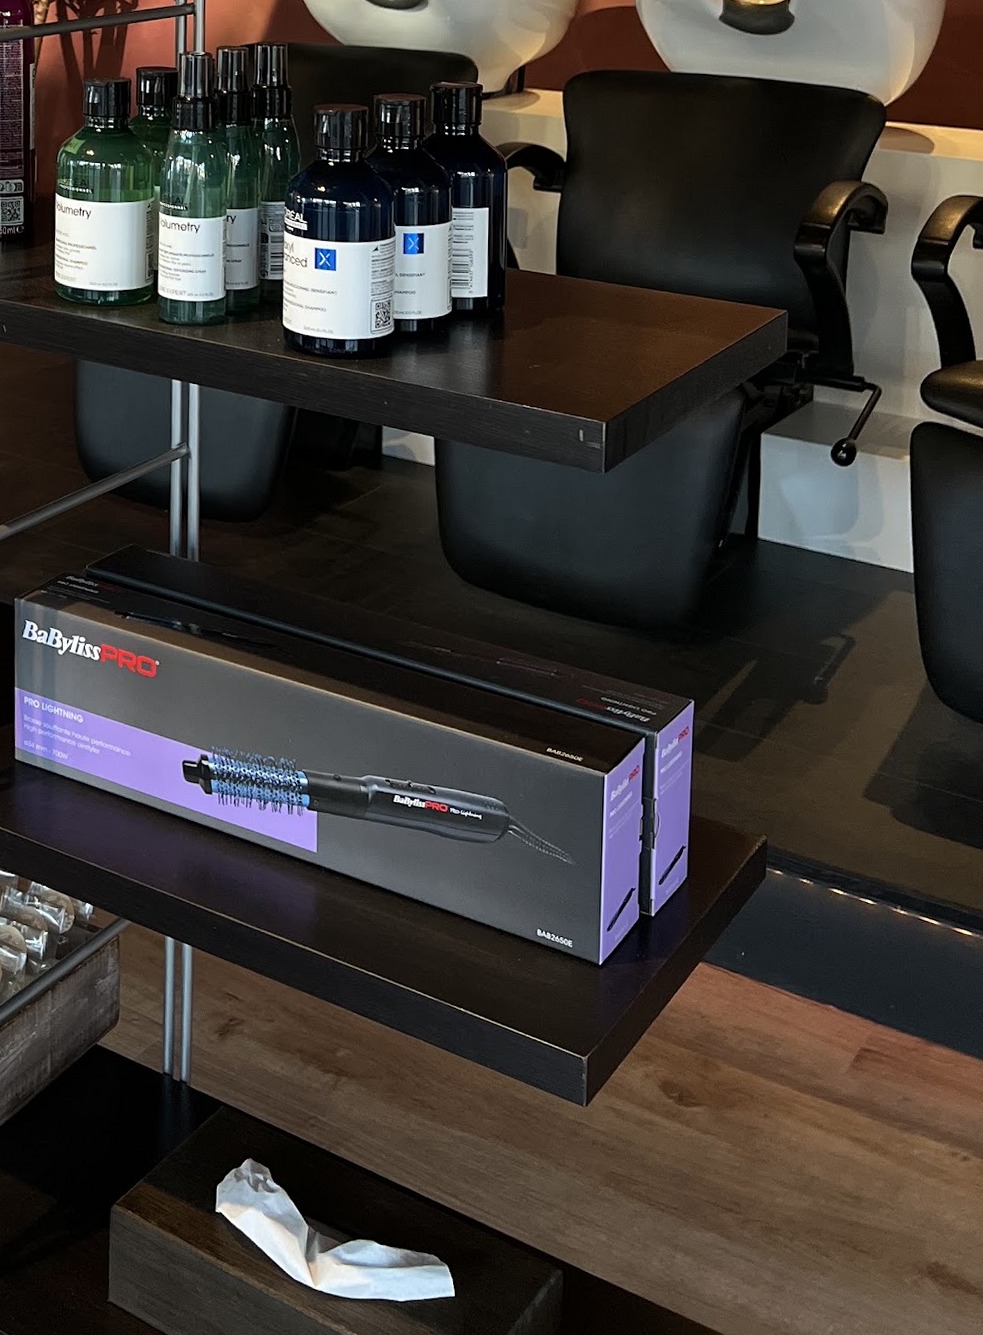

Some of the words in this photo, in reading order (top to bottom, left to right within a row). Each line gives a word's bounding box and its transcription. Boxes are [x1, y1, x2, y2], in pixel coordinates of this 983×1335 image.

[56, 202, 92, 219] olumetry
[160, 219, 200, 234] olumetry
[24, 696, 40, 708] PRO
[41, 702, 84, 723] LIGHTNING
[24, 723, 37, 733] High
[37, 727, 76, 745] performance
[72, 729, 90, 742] haute
[90, 737, 131, 757] performance
[536, 928, 573, 948] BAB2650E
